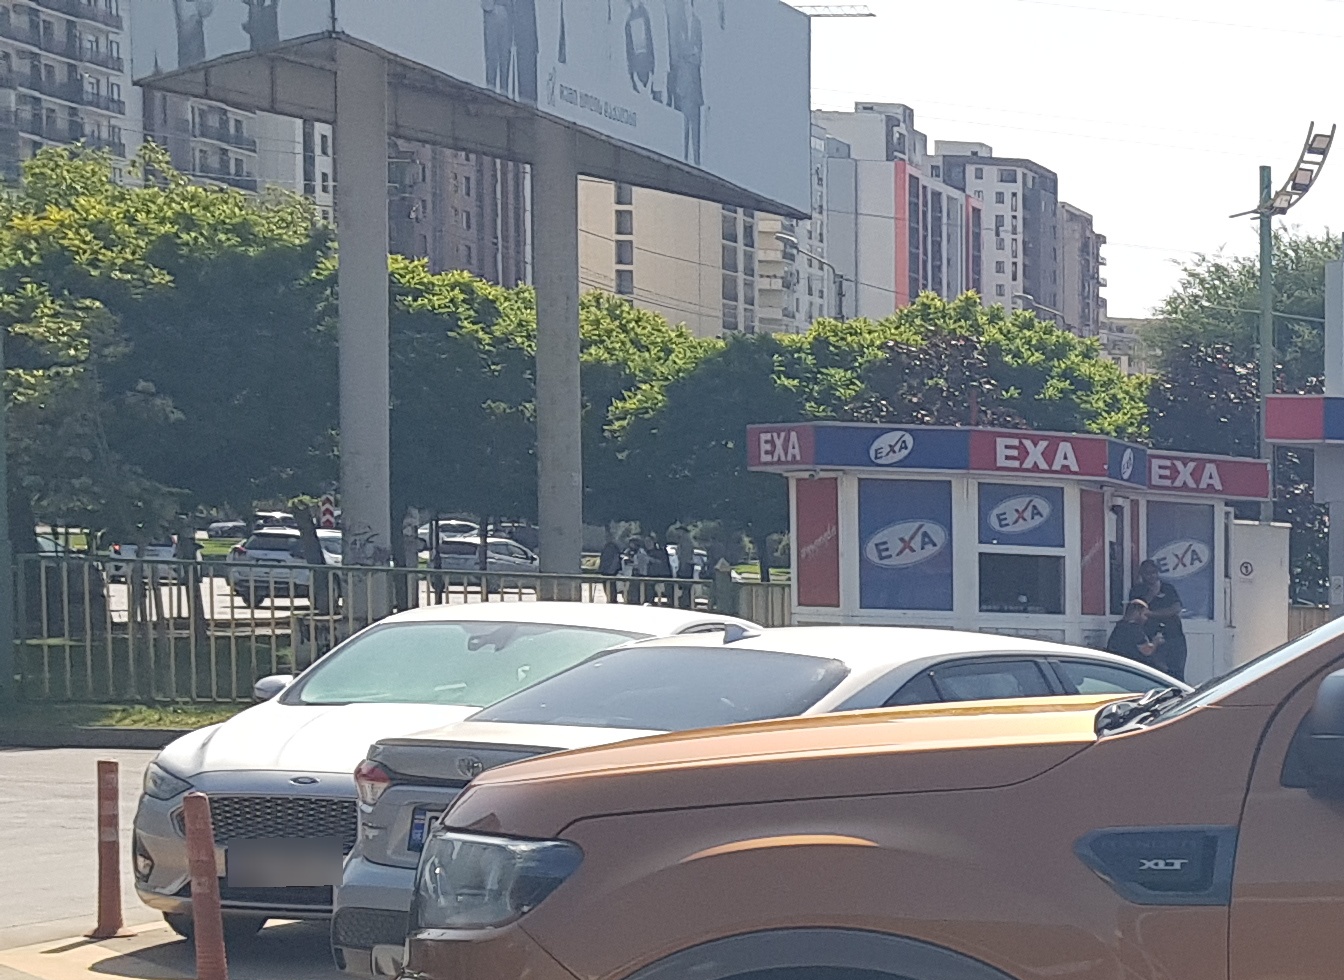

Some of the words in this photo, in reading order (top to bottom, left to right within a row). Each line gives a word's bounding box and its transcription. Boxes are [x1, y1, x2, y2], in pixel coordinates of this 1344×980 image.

[759, 431, 801, 462] EXA
[874, 433, 909, 460] EXA
[996, 437, 1080, 472] EXA
[1151, 458, 1222, 490] EXA
[995, 499, 1044, 528] EXA
[874, 523, 938, 561] EXA
[1156, 543, 1203, 574] EXA
[1138, 859, 1189, 870] XLT
